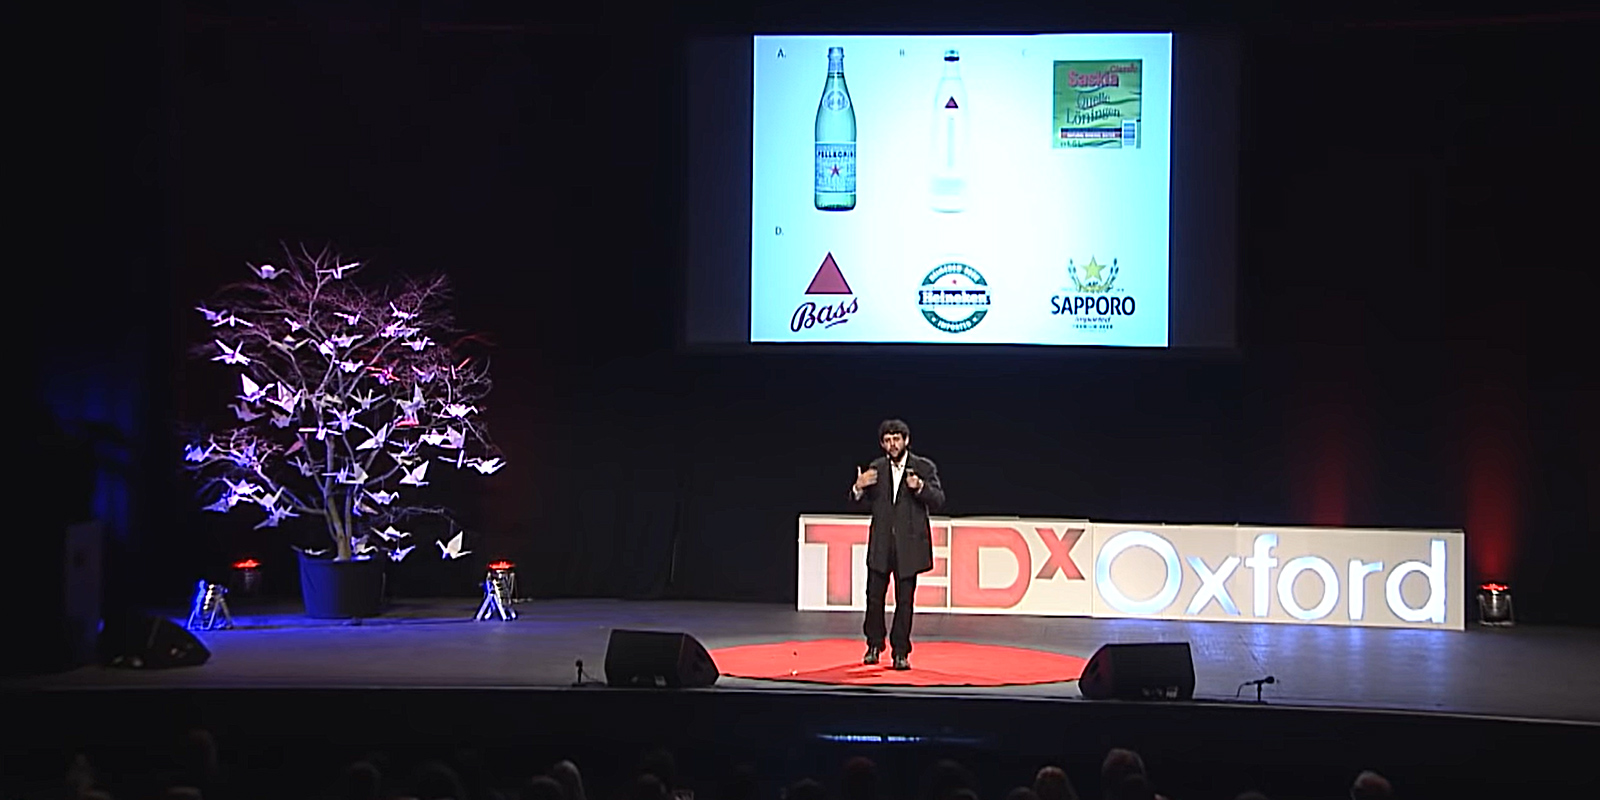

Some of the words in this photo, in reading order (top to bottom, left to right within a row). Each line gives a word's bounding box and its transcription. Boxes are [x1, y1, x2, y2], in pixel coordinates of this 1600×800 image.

[1068, 69, 1119, 87] Saskia
[790, 297, 858, 332] Bass
[1051, 295, 1136, 315] SAPPORO
